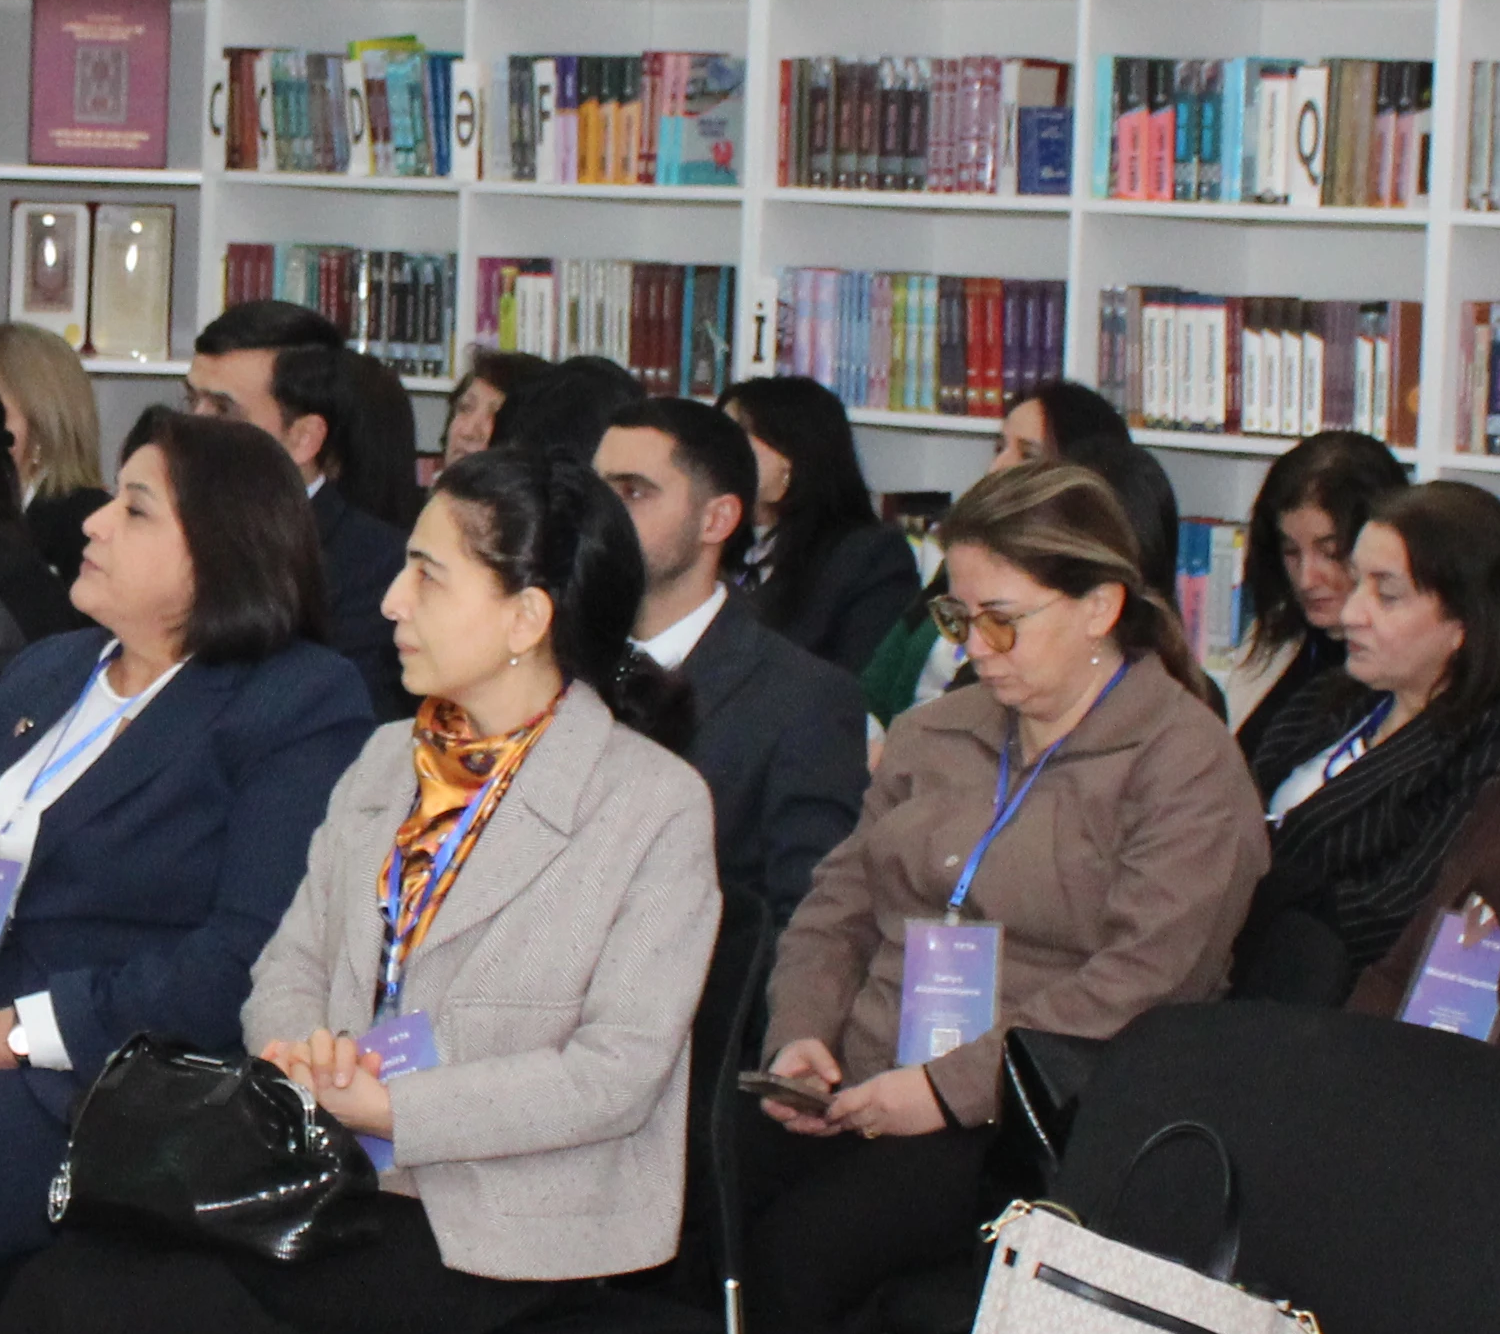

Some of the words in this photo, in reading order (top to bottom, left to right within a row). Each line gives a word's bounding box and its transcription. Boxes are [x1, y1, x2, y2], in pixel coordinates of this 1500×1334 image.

[350, 89, 363, 143] D
[458, 90, 475, 147] Ə
[539, 85, 551, 145] F
[1297, 101, 1320, 185] Q
